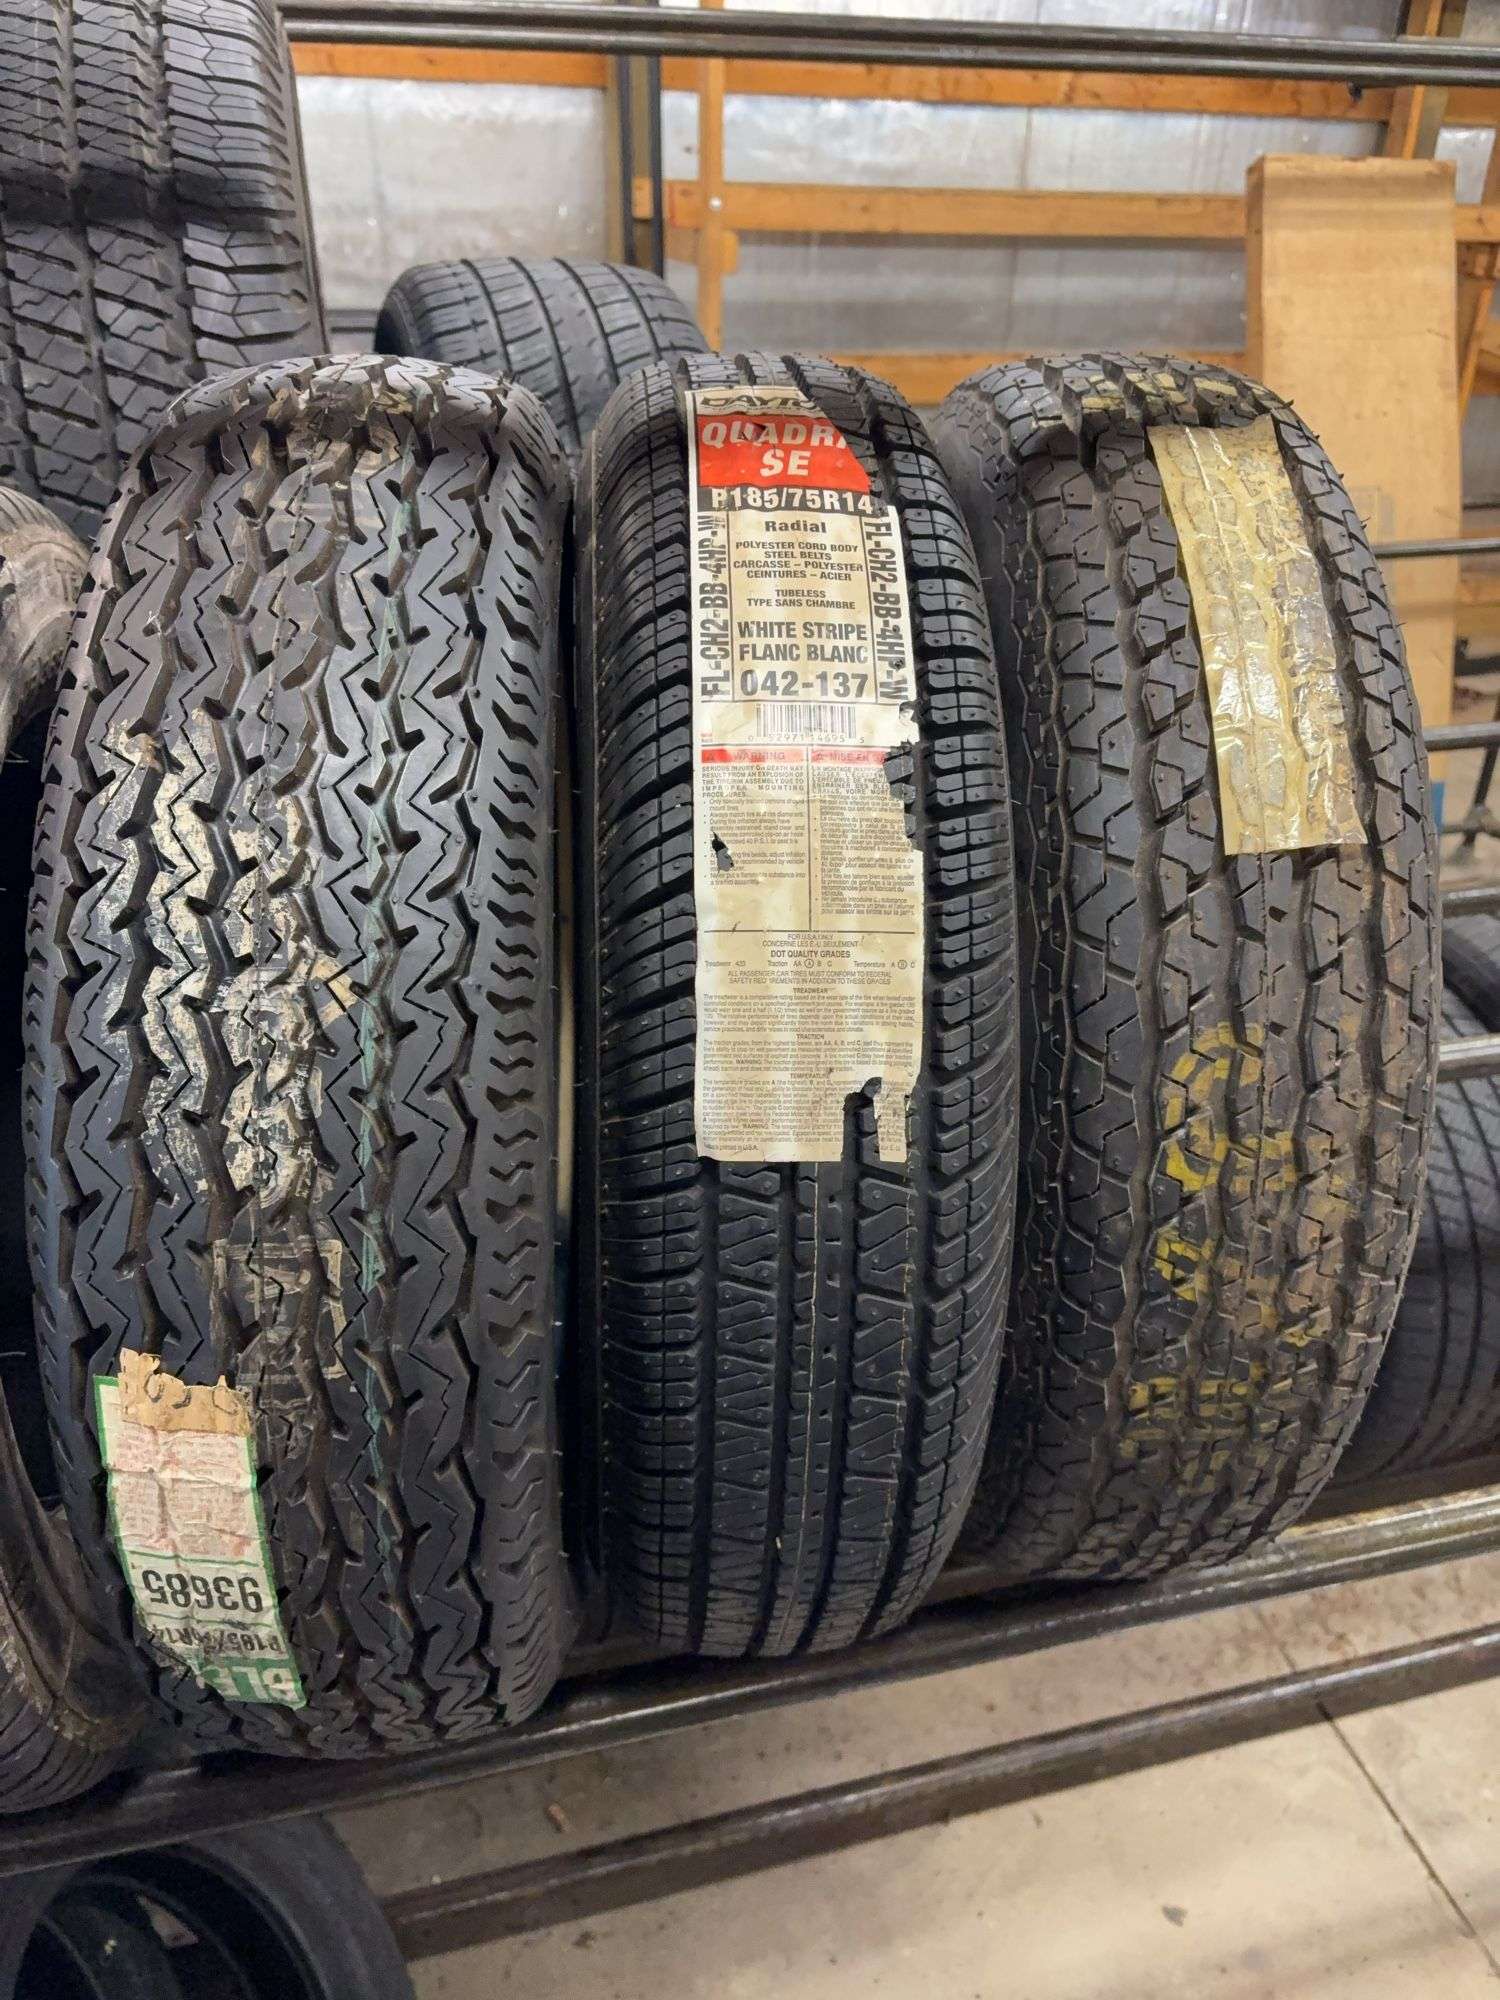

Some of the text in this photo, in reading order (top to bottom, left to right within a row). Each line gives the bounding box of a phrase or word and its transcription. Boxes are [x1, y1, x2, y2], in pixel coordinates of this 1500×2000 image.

[760, 449, 811, 477] SE
[710, 486, 874, 515] P185/75R14
[764, 520, 827, 533] Radial
[735, 540, 858, 553] POLYESTER CORD BODY
[764, 551, 832, 560] STEEL BELTS
[733, 560, 791, 569] CARCASSE
[804, 560, 863, 572] POLYESTER
[746, 569, 807, 579] CEINTURES
[819, 571, 852, 581] ACIER
[775, 588, 826, 598] TUBELESS
[746, 598, 856, 610] TYPE SANS CHAMBRE
[737, 621, 868, 641] WHITE STRIPE
[739, 643, 868, 664] FLANC BLANC
[740, 669, 869, 698] 042-137
[770, 950, 851, 958] DOT QUALITY GRADES
[141, 1569, 264, 1613] 93685
